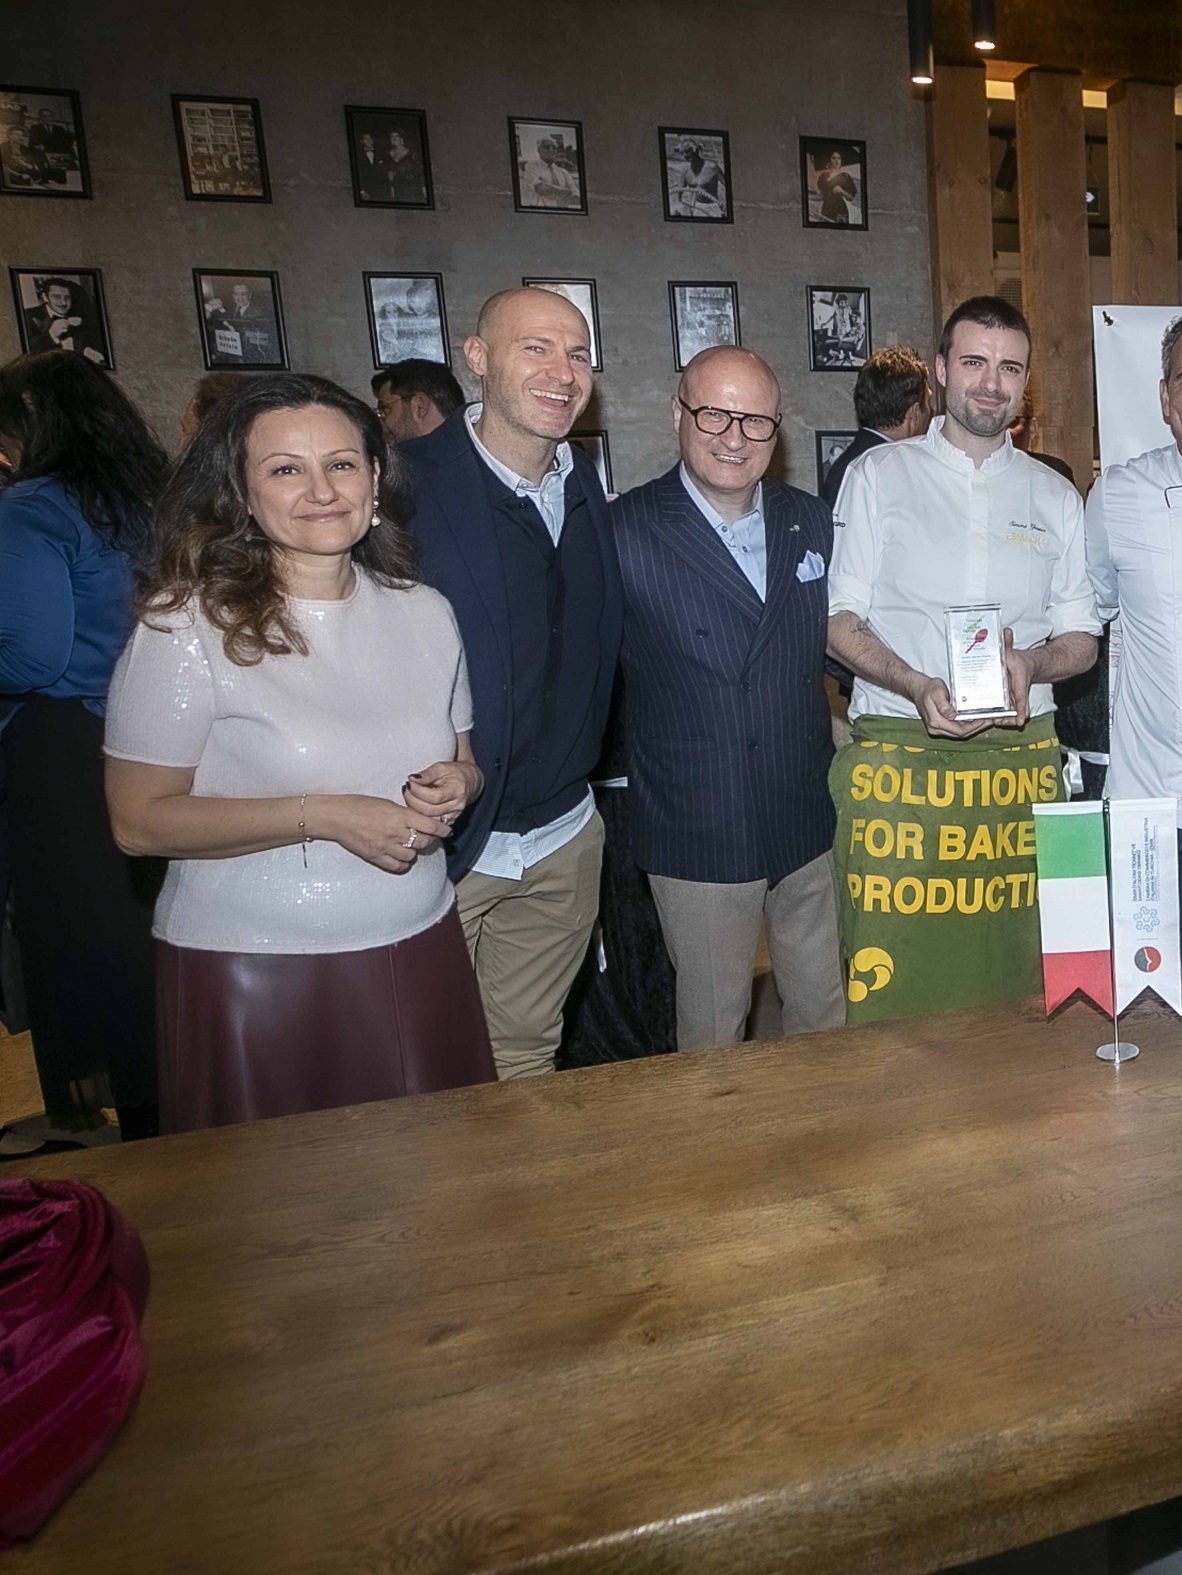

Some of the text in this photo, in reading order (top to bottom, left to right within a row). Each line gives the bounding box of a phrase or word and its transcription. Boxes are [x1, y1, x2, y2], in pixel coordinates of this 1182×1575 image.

[851, 764, 1058, 807] SOLUTIONS
[849, 818, 1036, 861] FOR BAKE
[848, 872, 1040, 914] PRODUCTI
